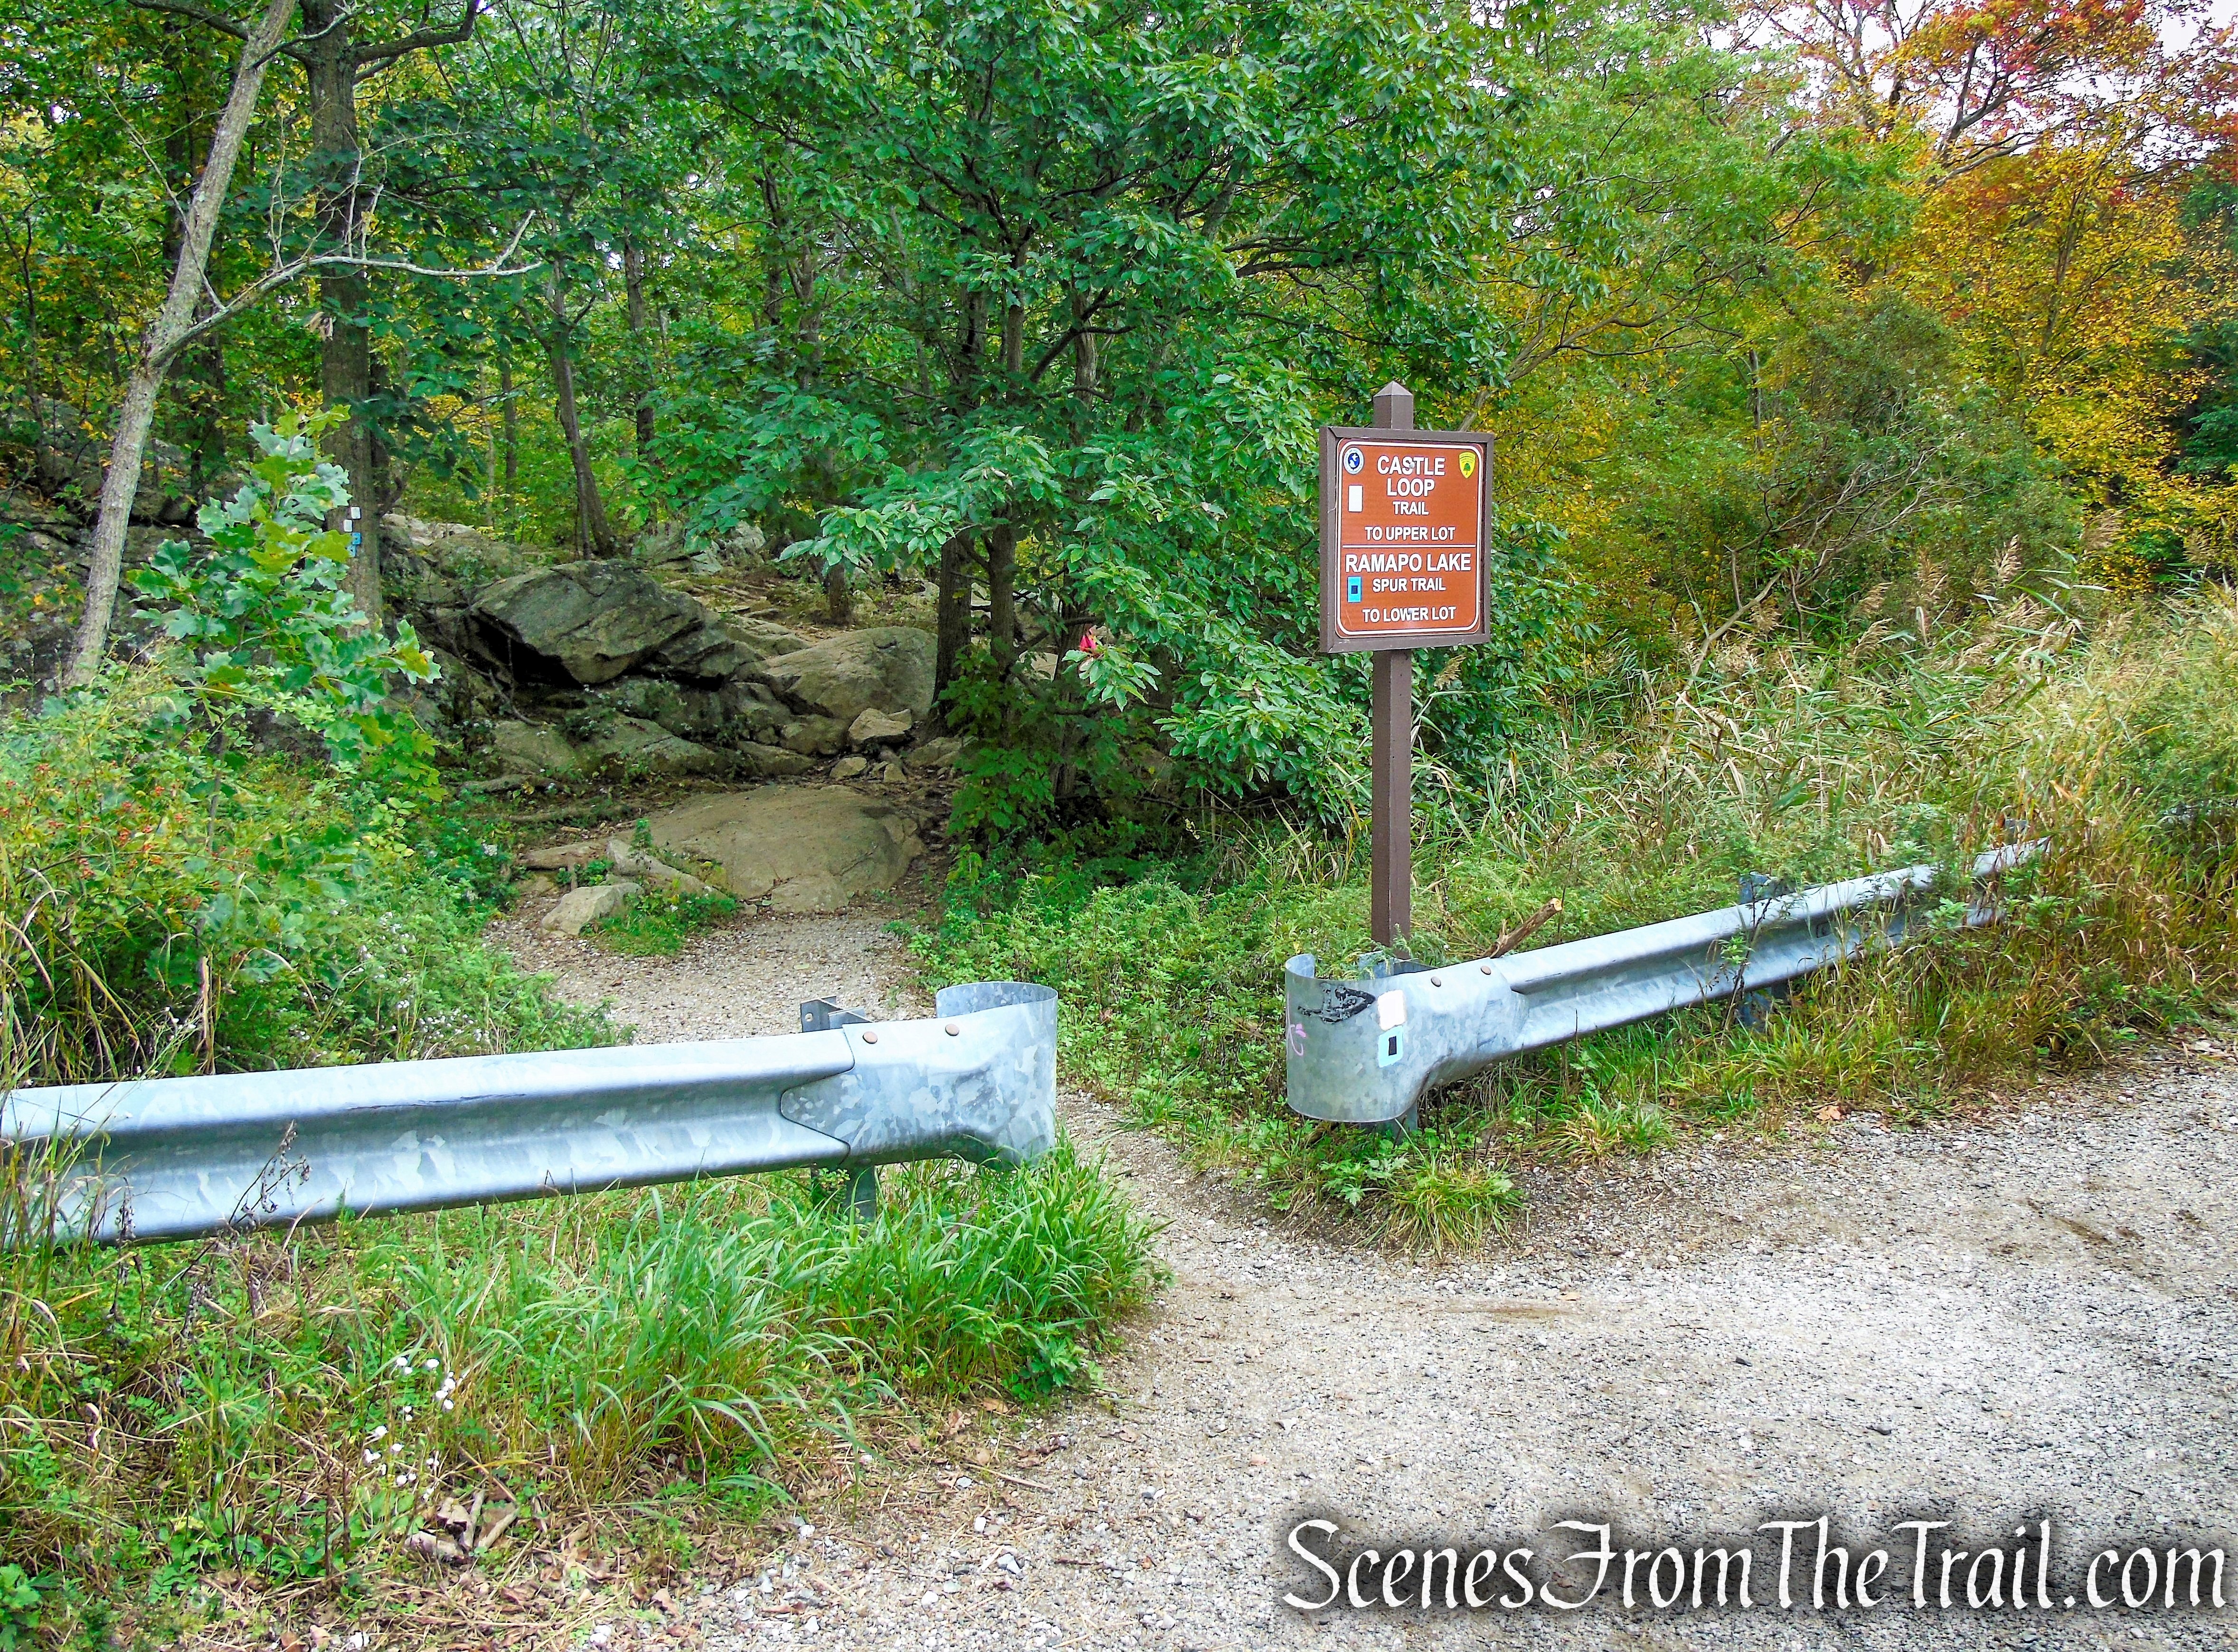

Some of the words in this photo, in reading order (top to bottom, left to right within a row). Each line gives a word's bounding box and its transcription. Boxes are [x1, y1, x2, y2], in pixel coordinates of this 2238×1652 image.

[1377, 455, 1445, 476] CASTLE
[1387, 478, 1435, 496] LOOP
[1392, 501, 1429, 515] TRAIL
[1364, 527, 1382, 540] TO
[1386, 526, 1428, 540] UPPER
[1431, 527, 1456, 540] LOT
[1345, 553, 1422, 573] RAMAPO
[1427, 553, 1471, 571] LAKE
[1372, 578, 1407, 592] SPUR
[1410, 577, 1446, 591] TRAIL
[1362, 608, 1380, 623] TO
[1383, 607, 1429, 623] LOWER
[1432, 606, 1456, 620] LOT
